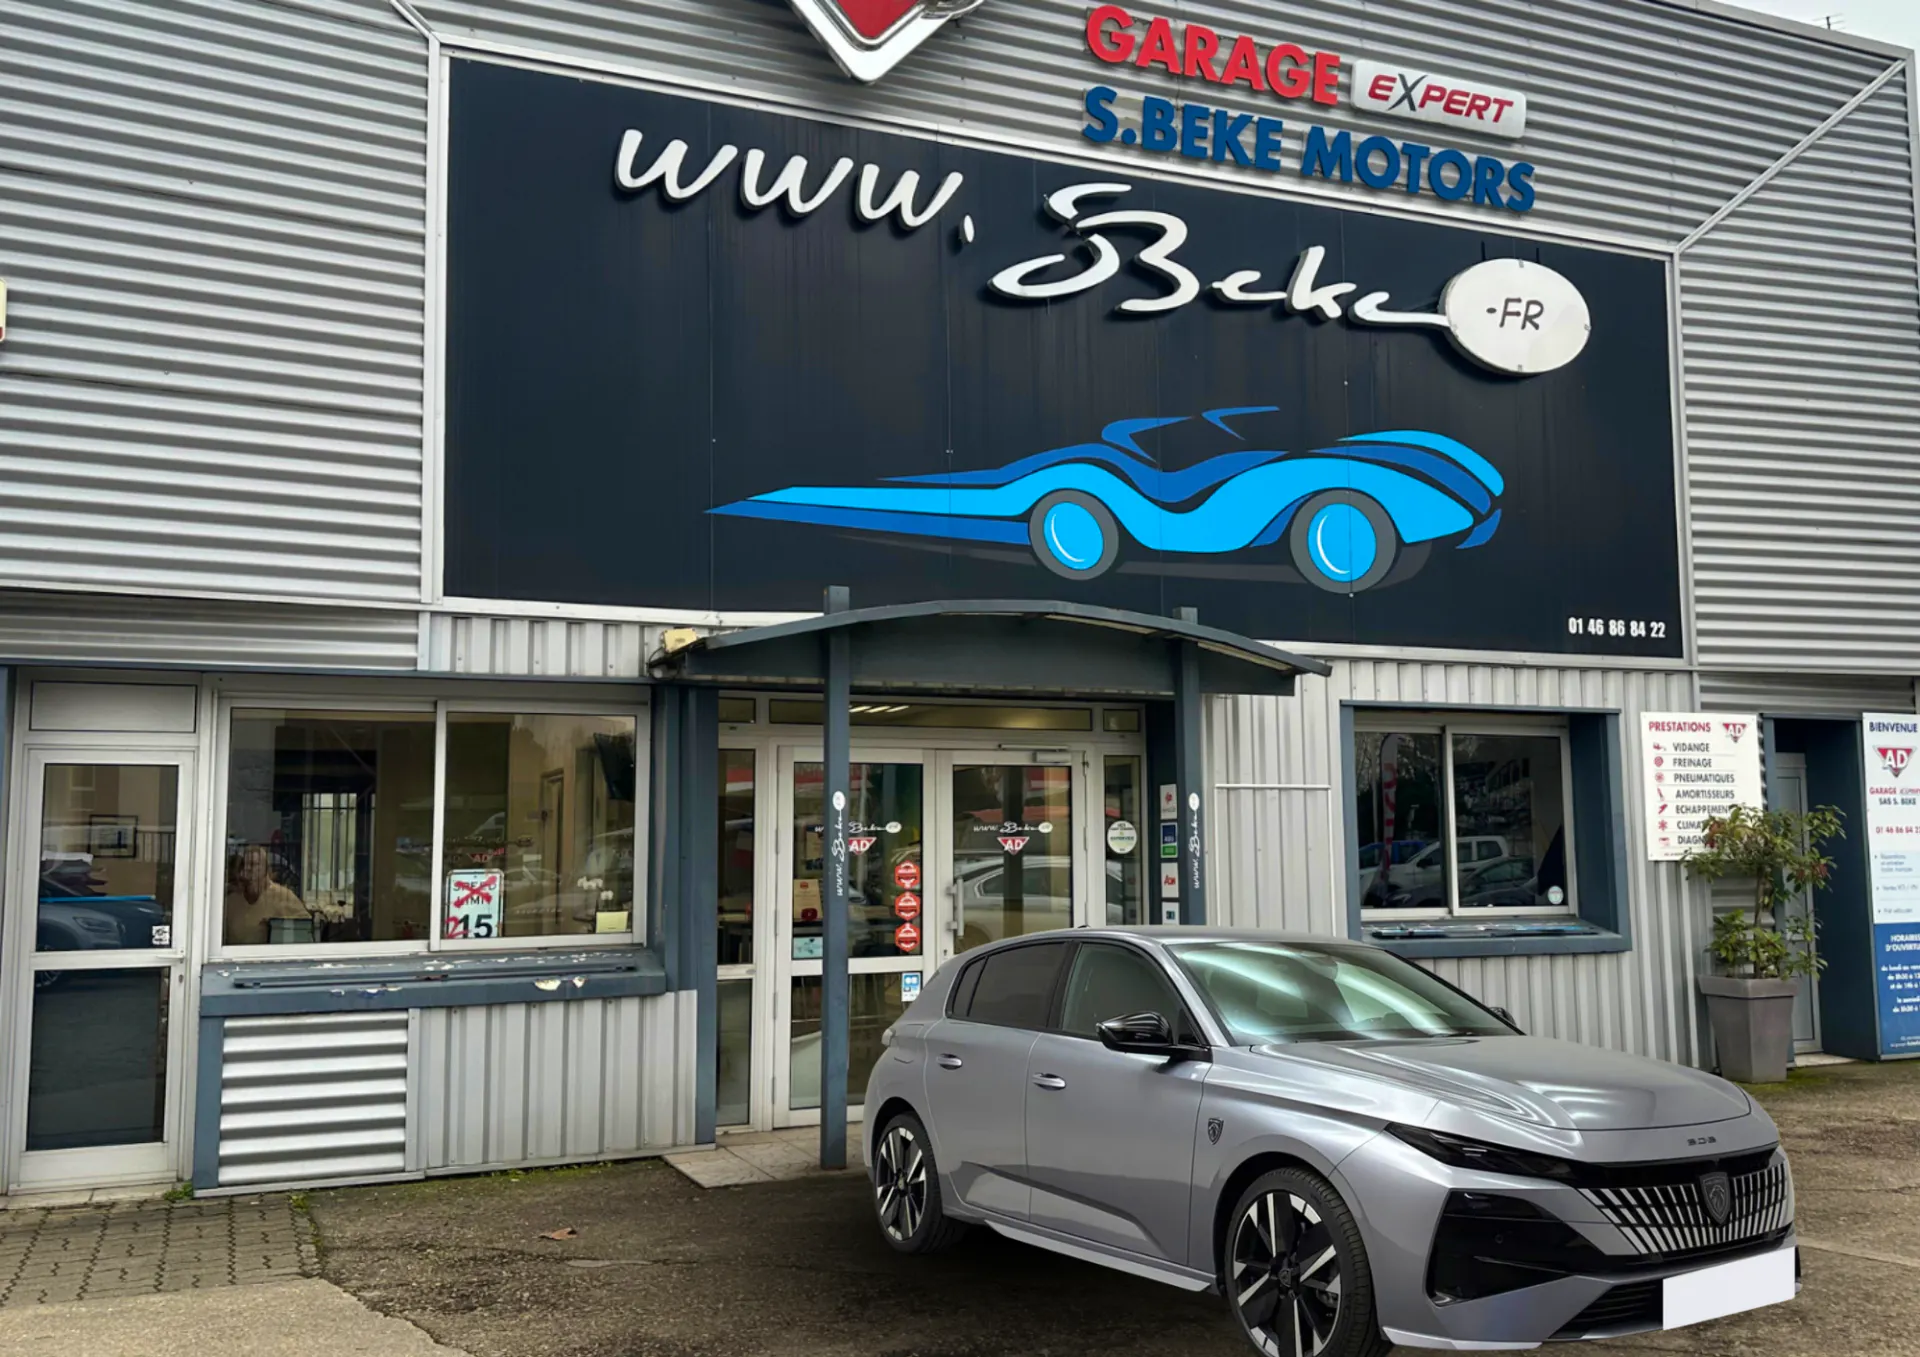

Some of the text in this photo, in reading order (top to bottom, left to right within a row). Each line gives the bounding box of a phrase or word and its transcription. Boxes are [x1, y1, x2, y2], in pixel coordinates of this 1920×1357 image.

[1086, 5, 1515, 123] GARAGE EXPERT
[1082, 86, 1536, 212] S.BEKE MOTORS
[1568, 617, 1666, 638] 01 46 86 84 22
[1648, 721, 1711, 732] PRESTATIONS
[1869, 722, 1918, 733] BIENVENUE
[1672, 742, 1710, 752] VIDANGE
[1672, 758, 1712, 768] FREINAGE
[1674, 773, 1735, 784] PNEUMATIQUES
[1675, 789, 1735, 799] AMORTISSEURS
[1869, 787, 1896, 795] GARAGE
[1675, 805, 1731, 814] ECHAPPEMEN
[1004, 840, 1022, 851] AD
